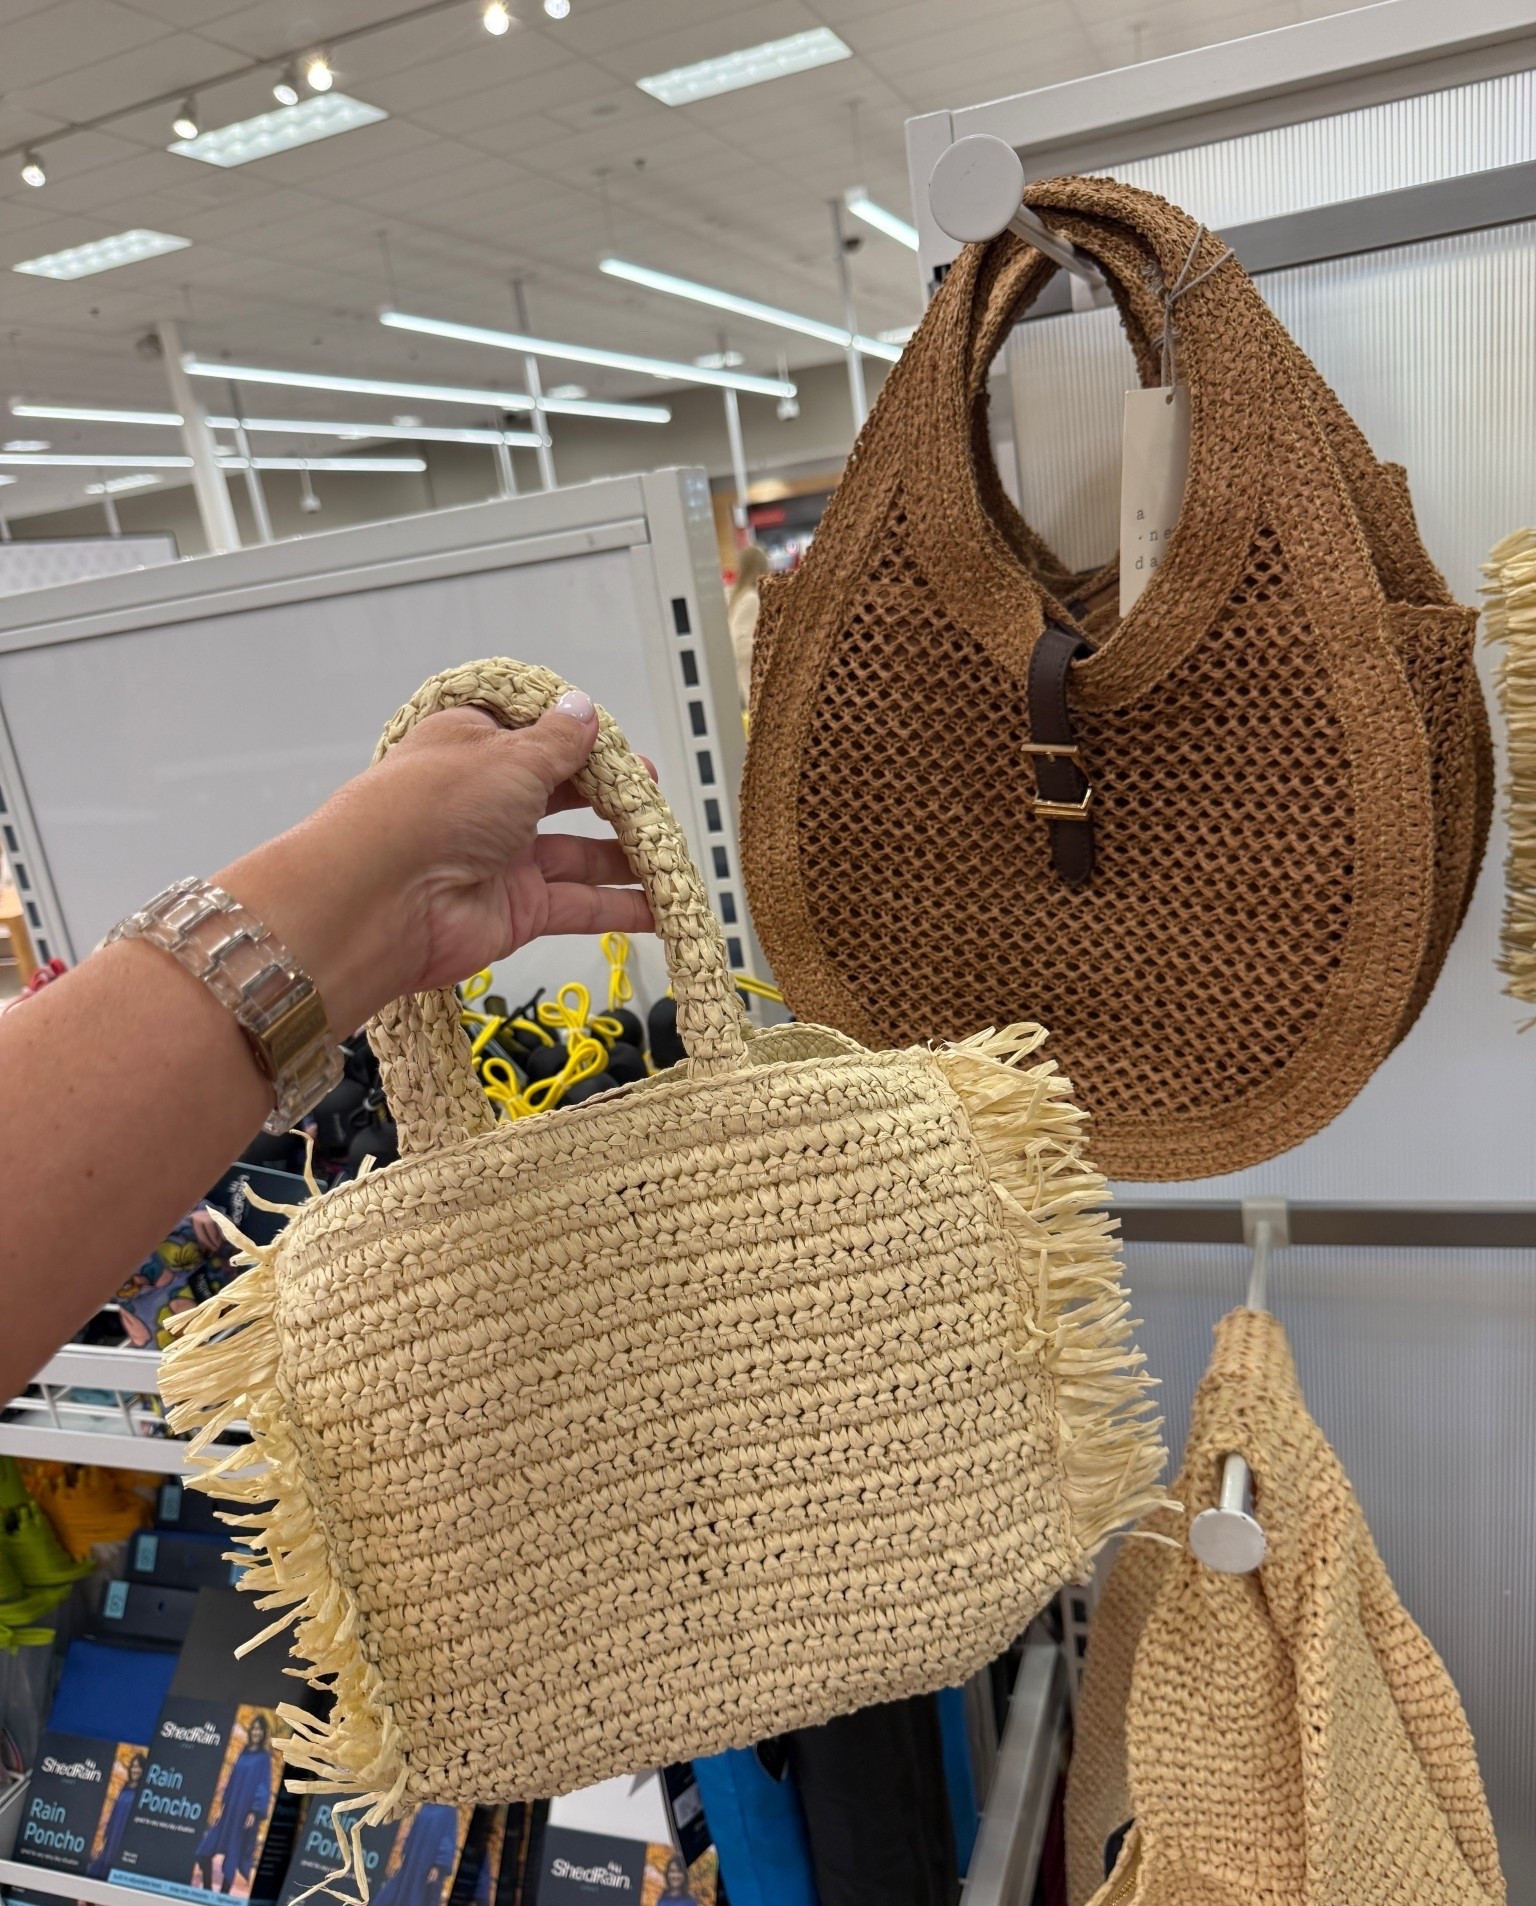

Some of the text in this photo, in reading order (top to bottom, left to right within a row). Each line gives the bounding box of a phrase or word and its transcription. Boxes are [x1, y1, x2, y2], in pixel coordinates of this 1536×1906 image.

[1136, 509, 1144, 520] a
[1149, 529, 1171, 541] ne
[1135, 556, 1157, 571] da
[160, 1721, 221, 1746] ShedRain
[41, 1756, 102, 1783] ShedRain
[146, 1764, 183, 1790] Rain
[29, 1798, 66, 1824] Rain
[138, 1788, 202, 1820] Poncho
[24, 1821, 85, 1853] Poncho
[305, 1830, 380, 1870] Pono
[551, 1858, 631, 1889] ShedRain
